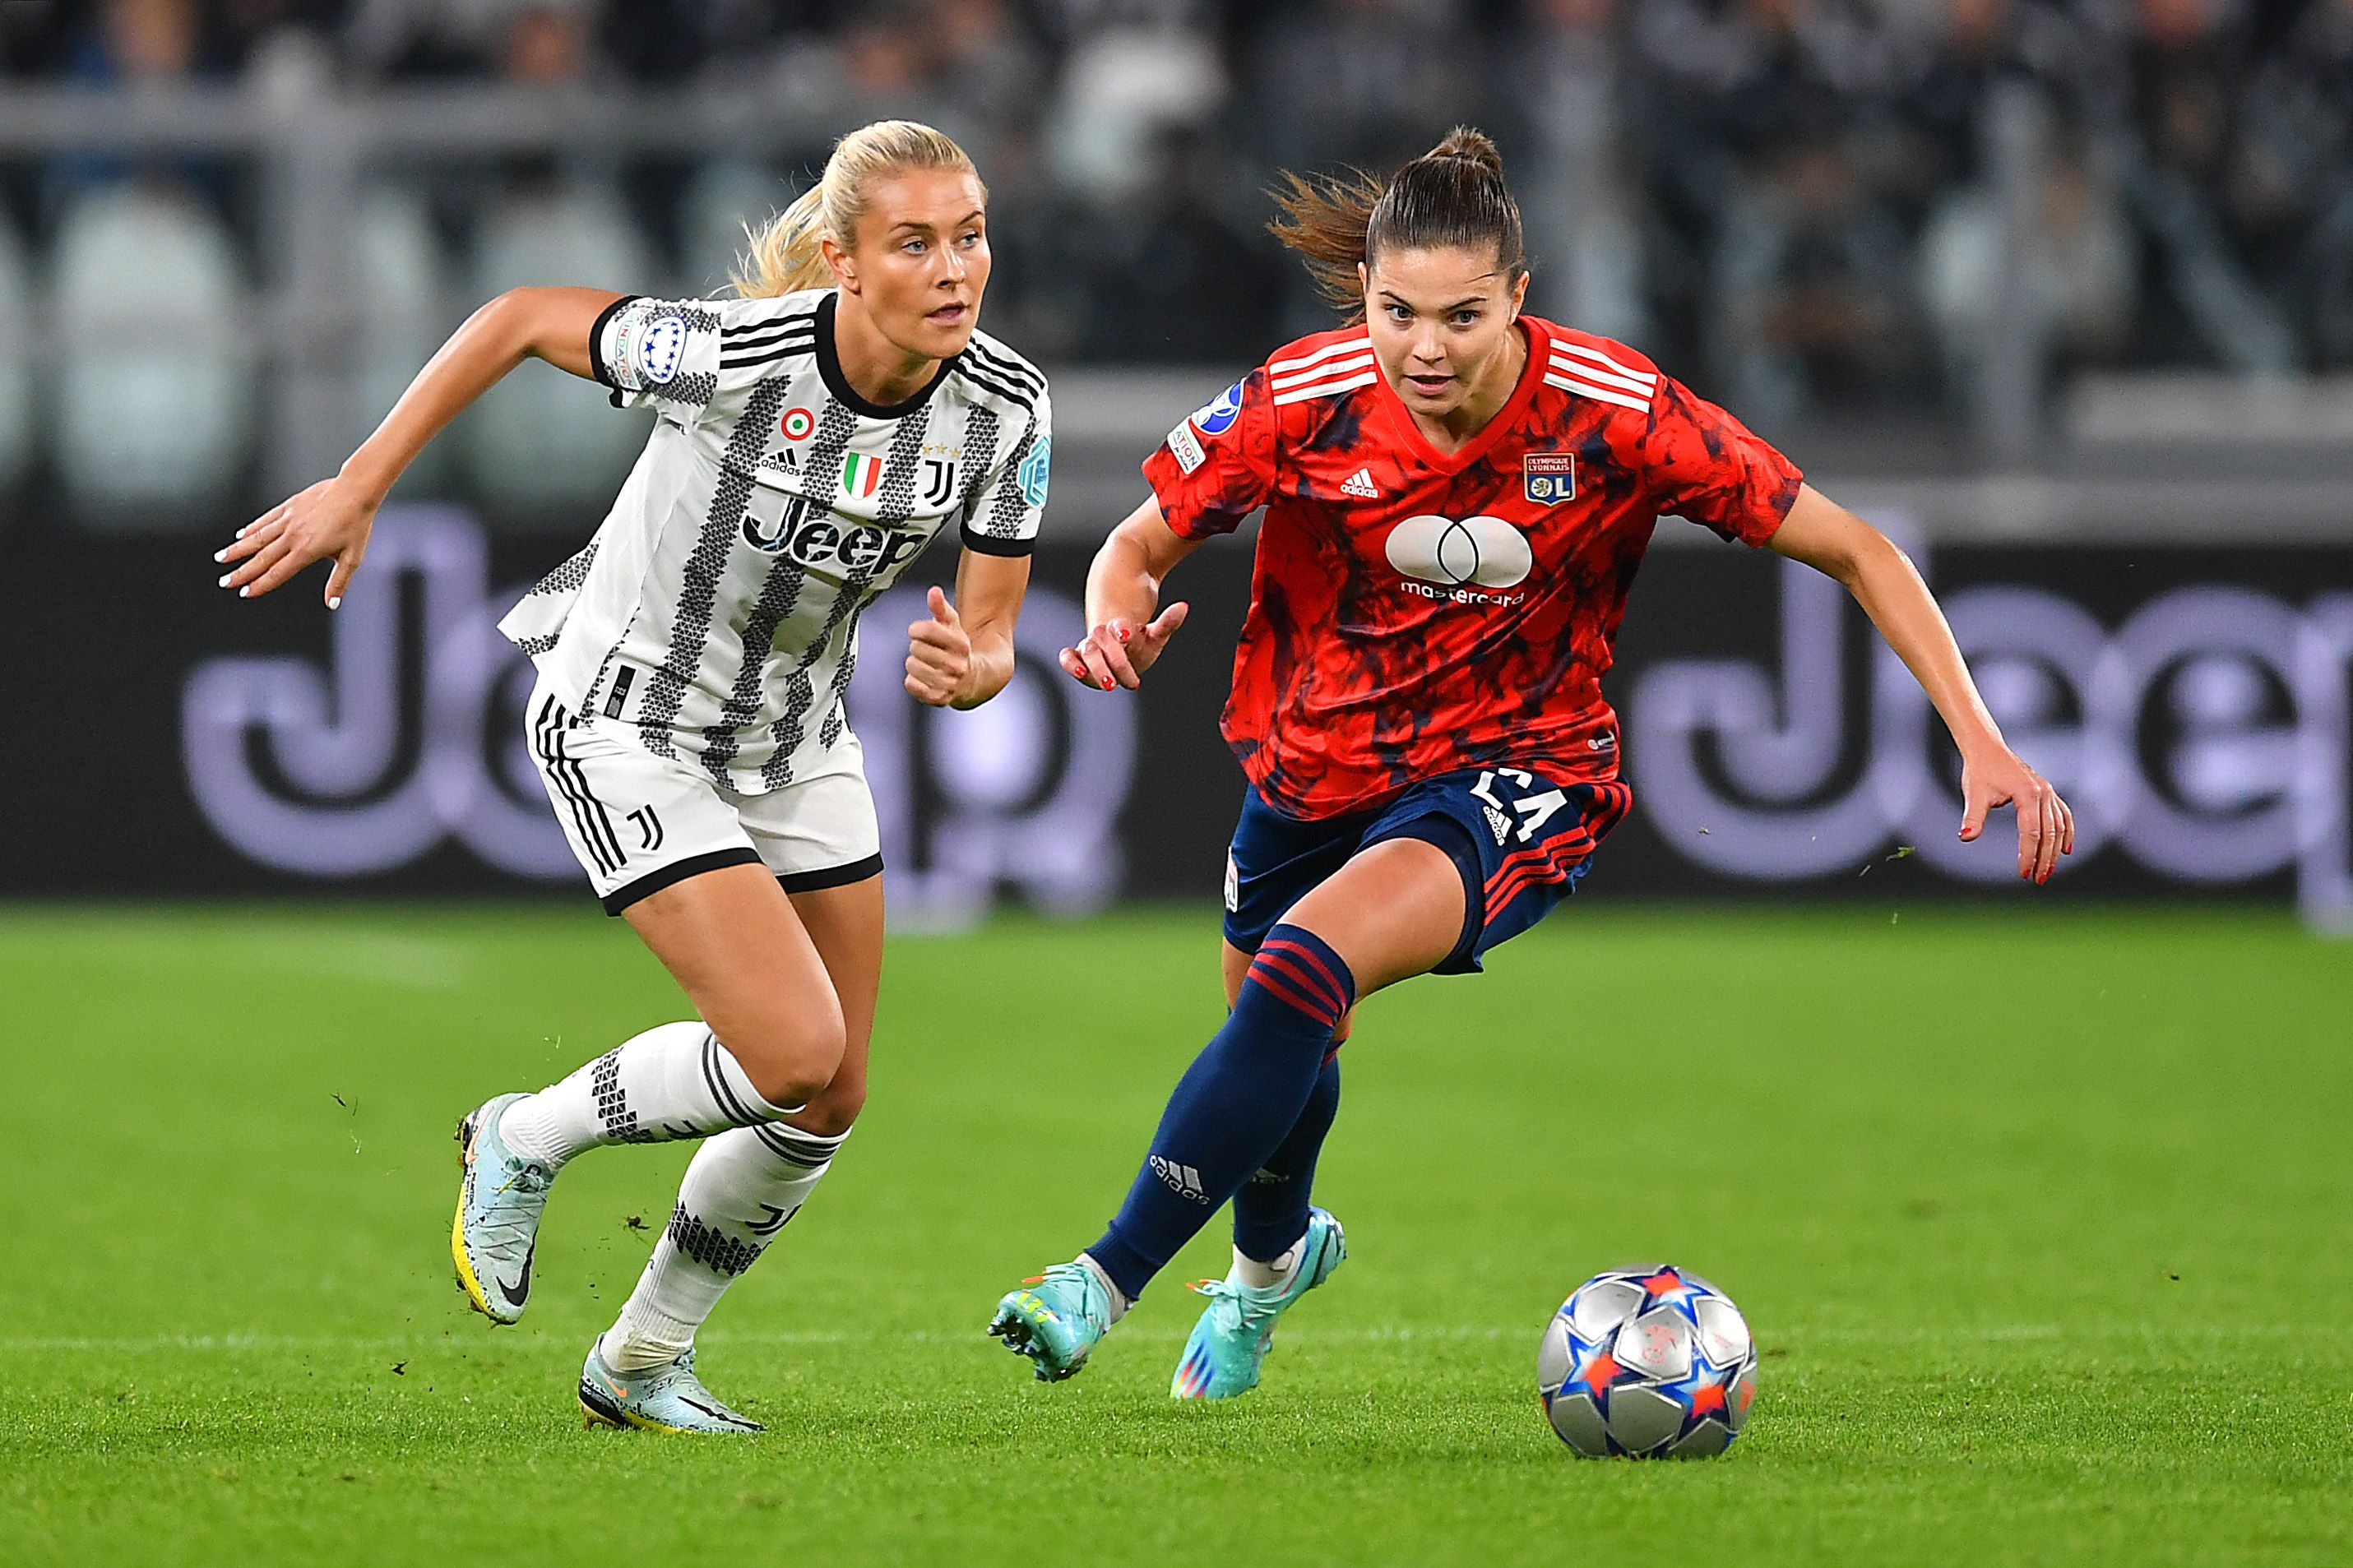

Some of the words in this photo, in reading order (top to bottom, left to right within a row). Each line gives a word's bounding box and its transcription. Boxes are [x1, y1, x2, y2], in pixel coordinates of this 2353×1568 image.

[761, 459, 801, 477] adidas
[1527, 457, 1569, 465] OLYMPIQUE
[1528, 464, 1570, 472] LYONNAIS
[1340, 483, 1378, 498] adidas
[739, 495, 929, 576] Jeep
[1401, 581, 1525, 608] mastercard
[1483, 806, 1505, 846] adidas
[1149, 1154, 1211, 1205] adidas
